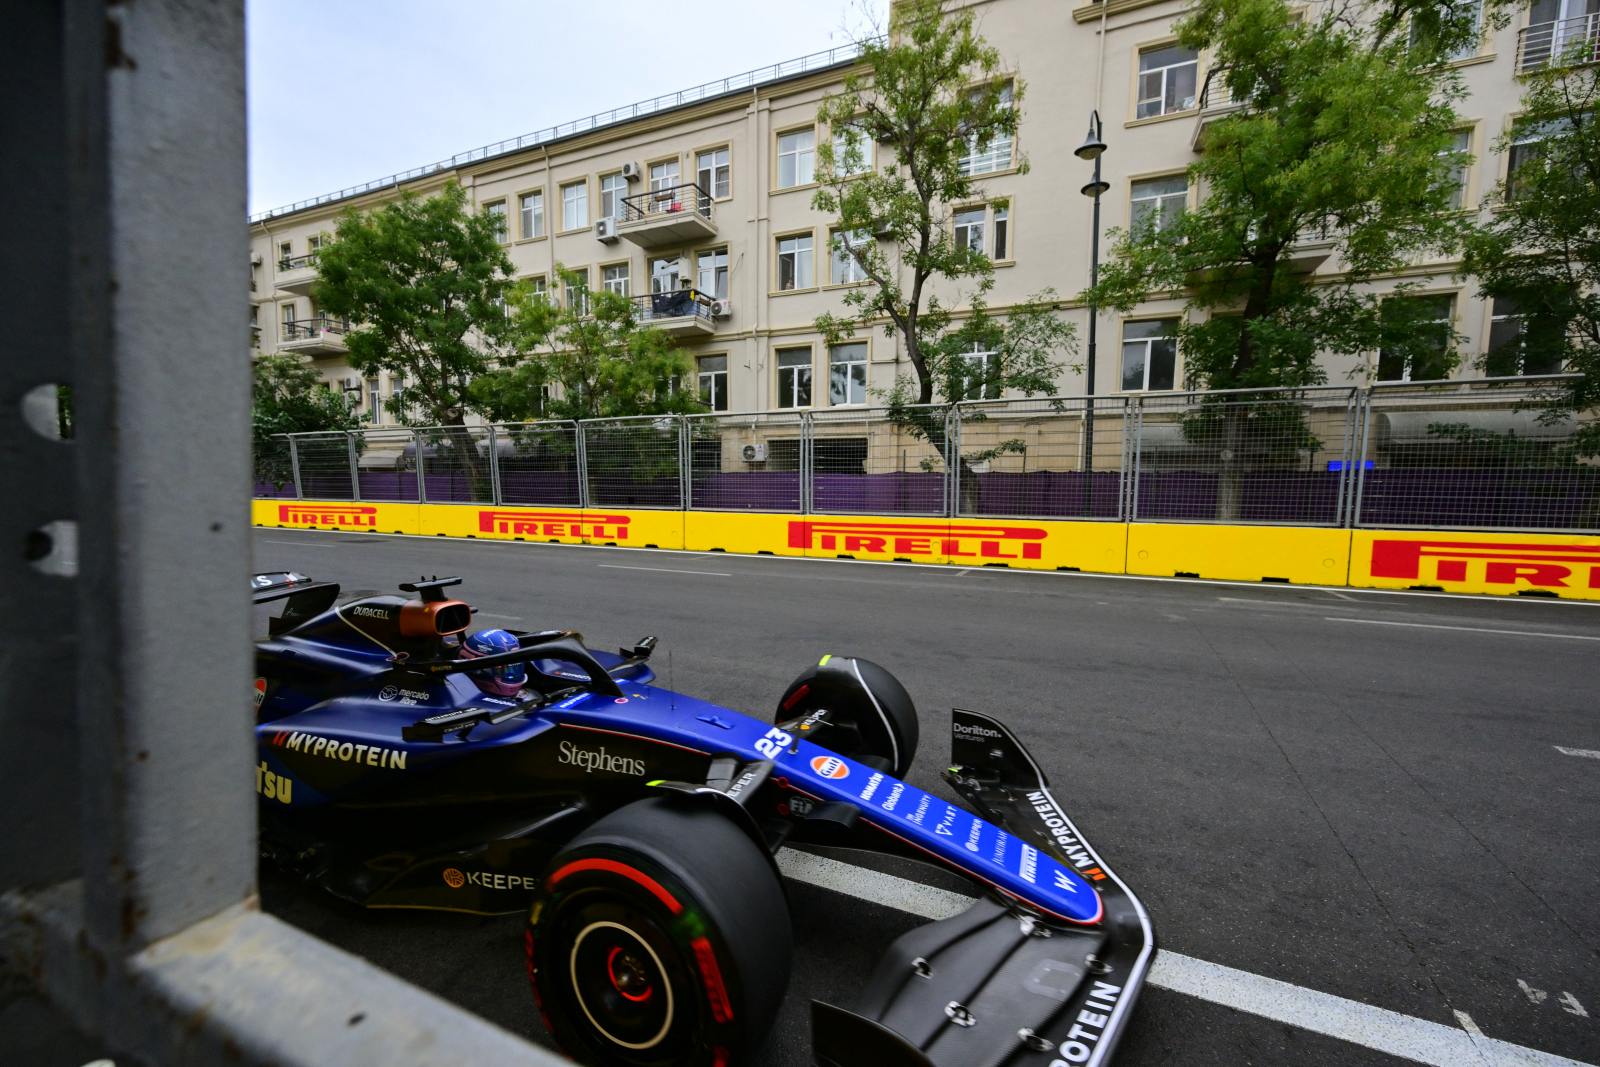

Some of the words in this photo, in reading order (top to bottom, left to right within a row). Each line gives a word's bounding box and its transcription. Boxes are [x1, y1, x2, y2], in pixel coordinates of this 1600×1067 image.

[279, 505, 377, 526] PIRELLI
[479, 511, 631, 539] PIRELLI
[788, 521, 1048, 559] PIRELLI
[1370, 540, 1600, 589] PIR
[353, 606, 390, 620] DURACELL
[399, 689, 430, 701] mercado
[285, 731, 408, 770] MYPROTEIN
[558, 740, 645, 776] Stephens
[754, 727, 792, 760] 23
[859, 772, 884, 801] KOMATSU
[942, 805, 958, 827] VAST
[1026, 791, 1095, 868] MYPROTEIN
[1018, 843, 1038, 884] PIRELLI
[466, 871, 536, 890] KEEPE
[1047, 980, 1121, 1067] OTEIN
